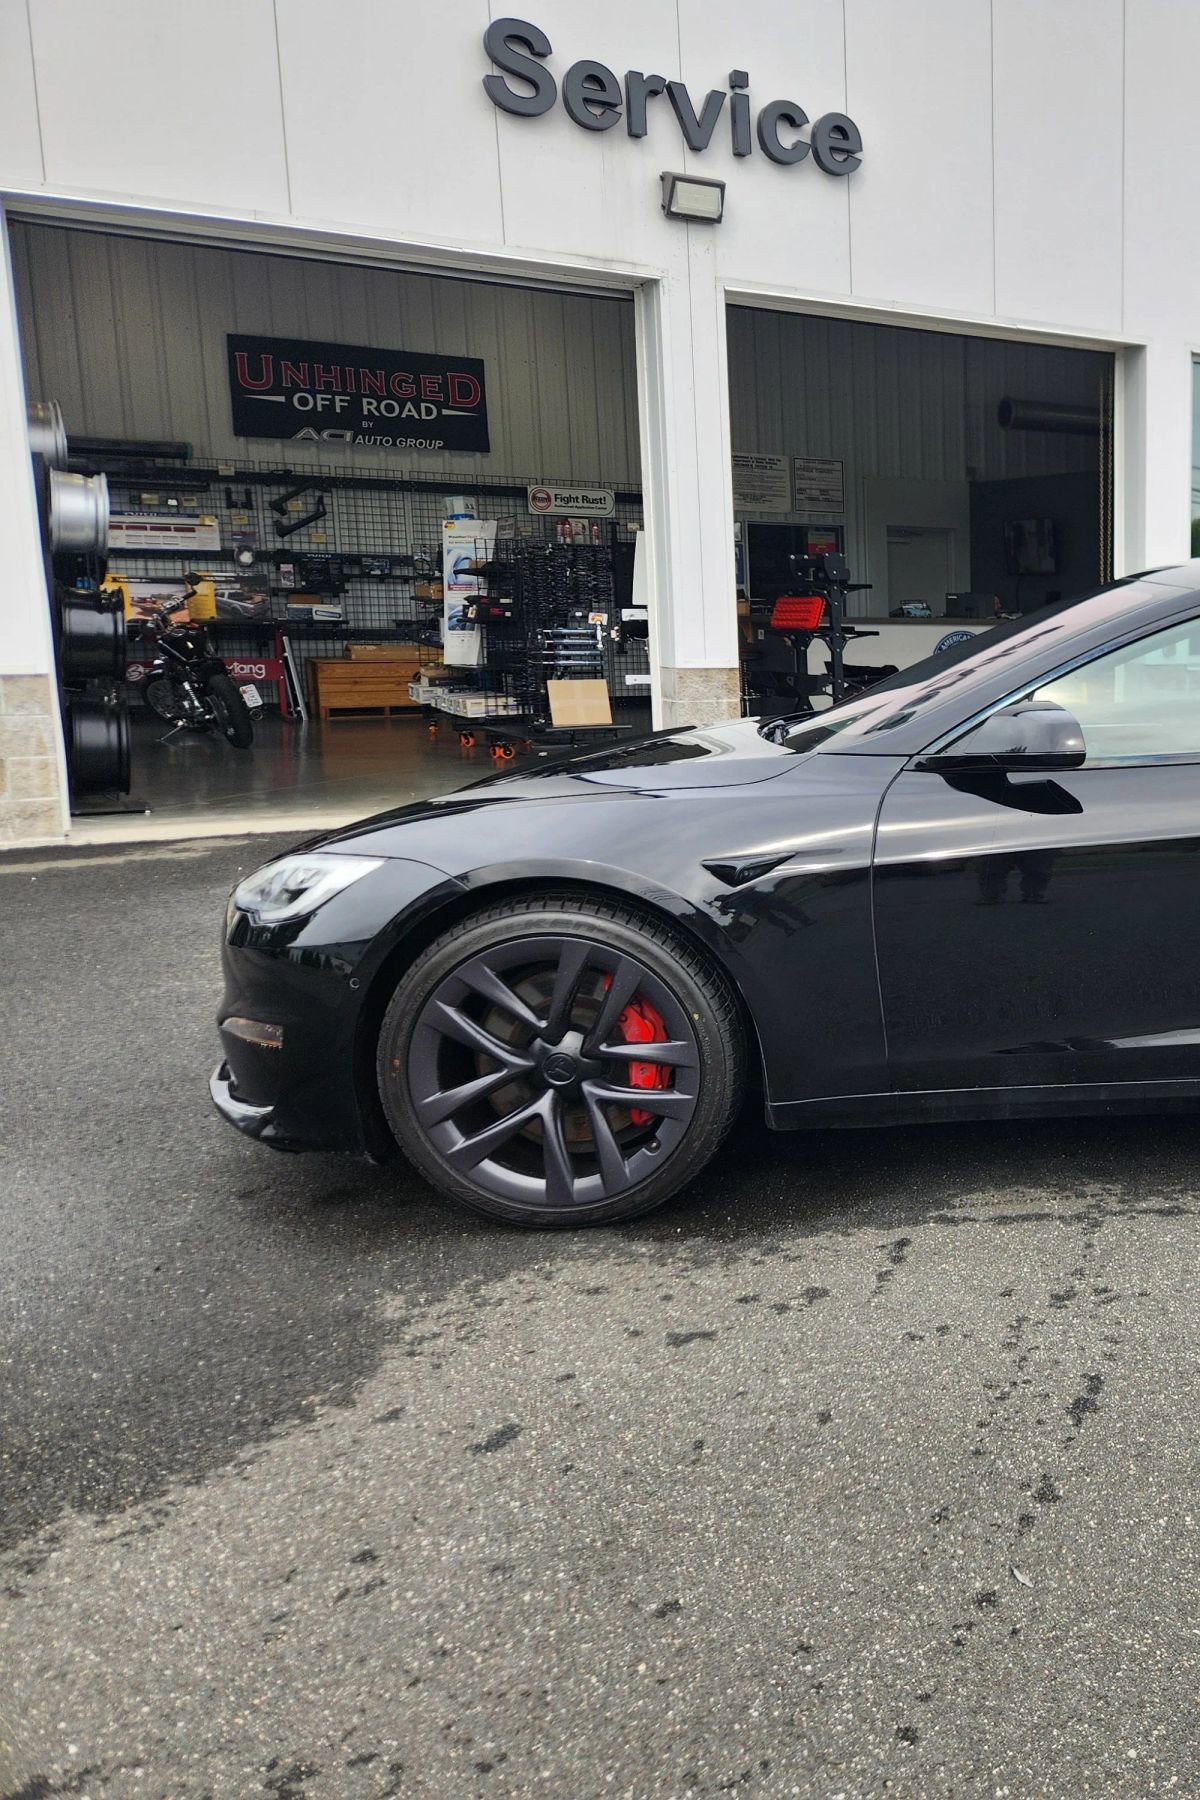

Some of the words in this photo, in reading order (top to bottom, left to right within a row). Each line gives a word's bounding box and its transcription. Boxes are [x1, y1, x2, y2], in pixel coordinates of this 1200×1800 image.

[482, 17, 863, 176] Service
[292, 392, 350, 413] OFF
[362, 398, 438, 420] ROAD
[362, 420, 374, 428] BY
[355, 434, 392, 446] AUTO
[396, 437, 444, 449] GROUP
[554, 493, 580, 505] Fight
[581, 494, 607, 505] Rust!
